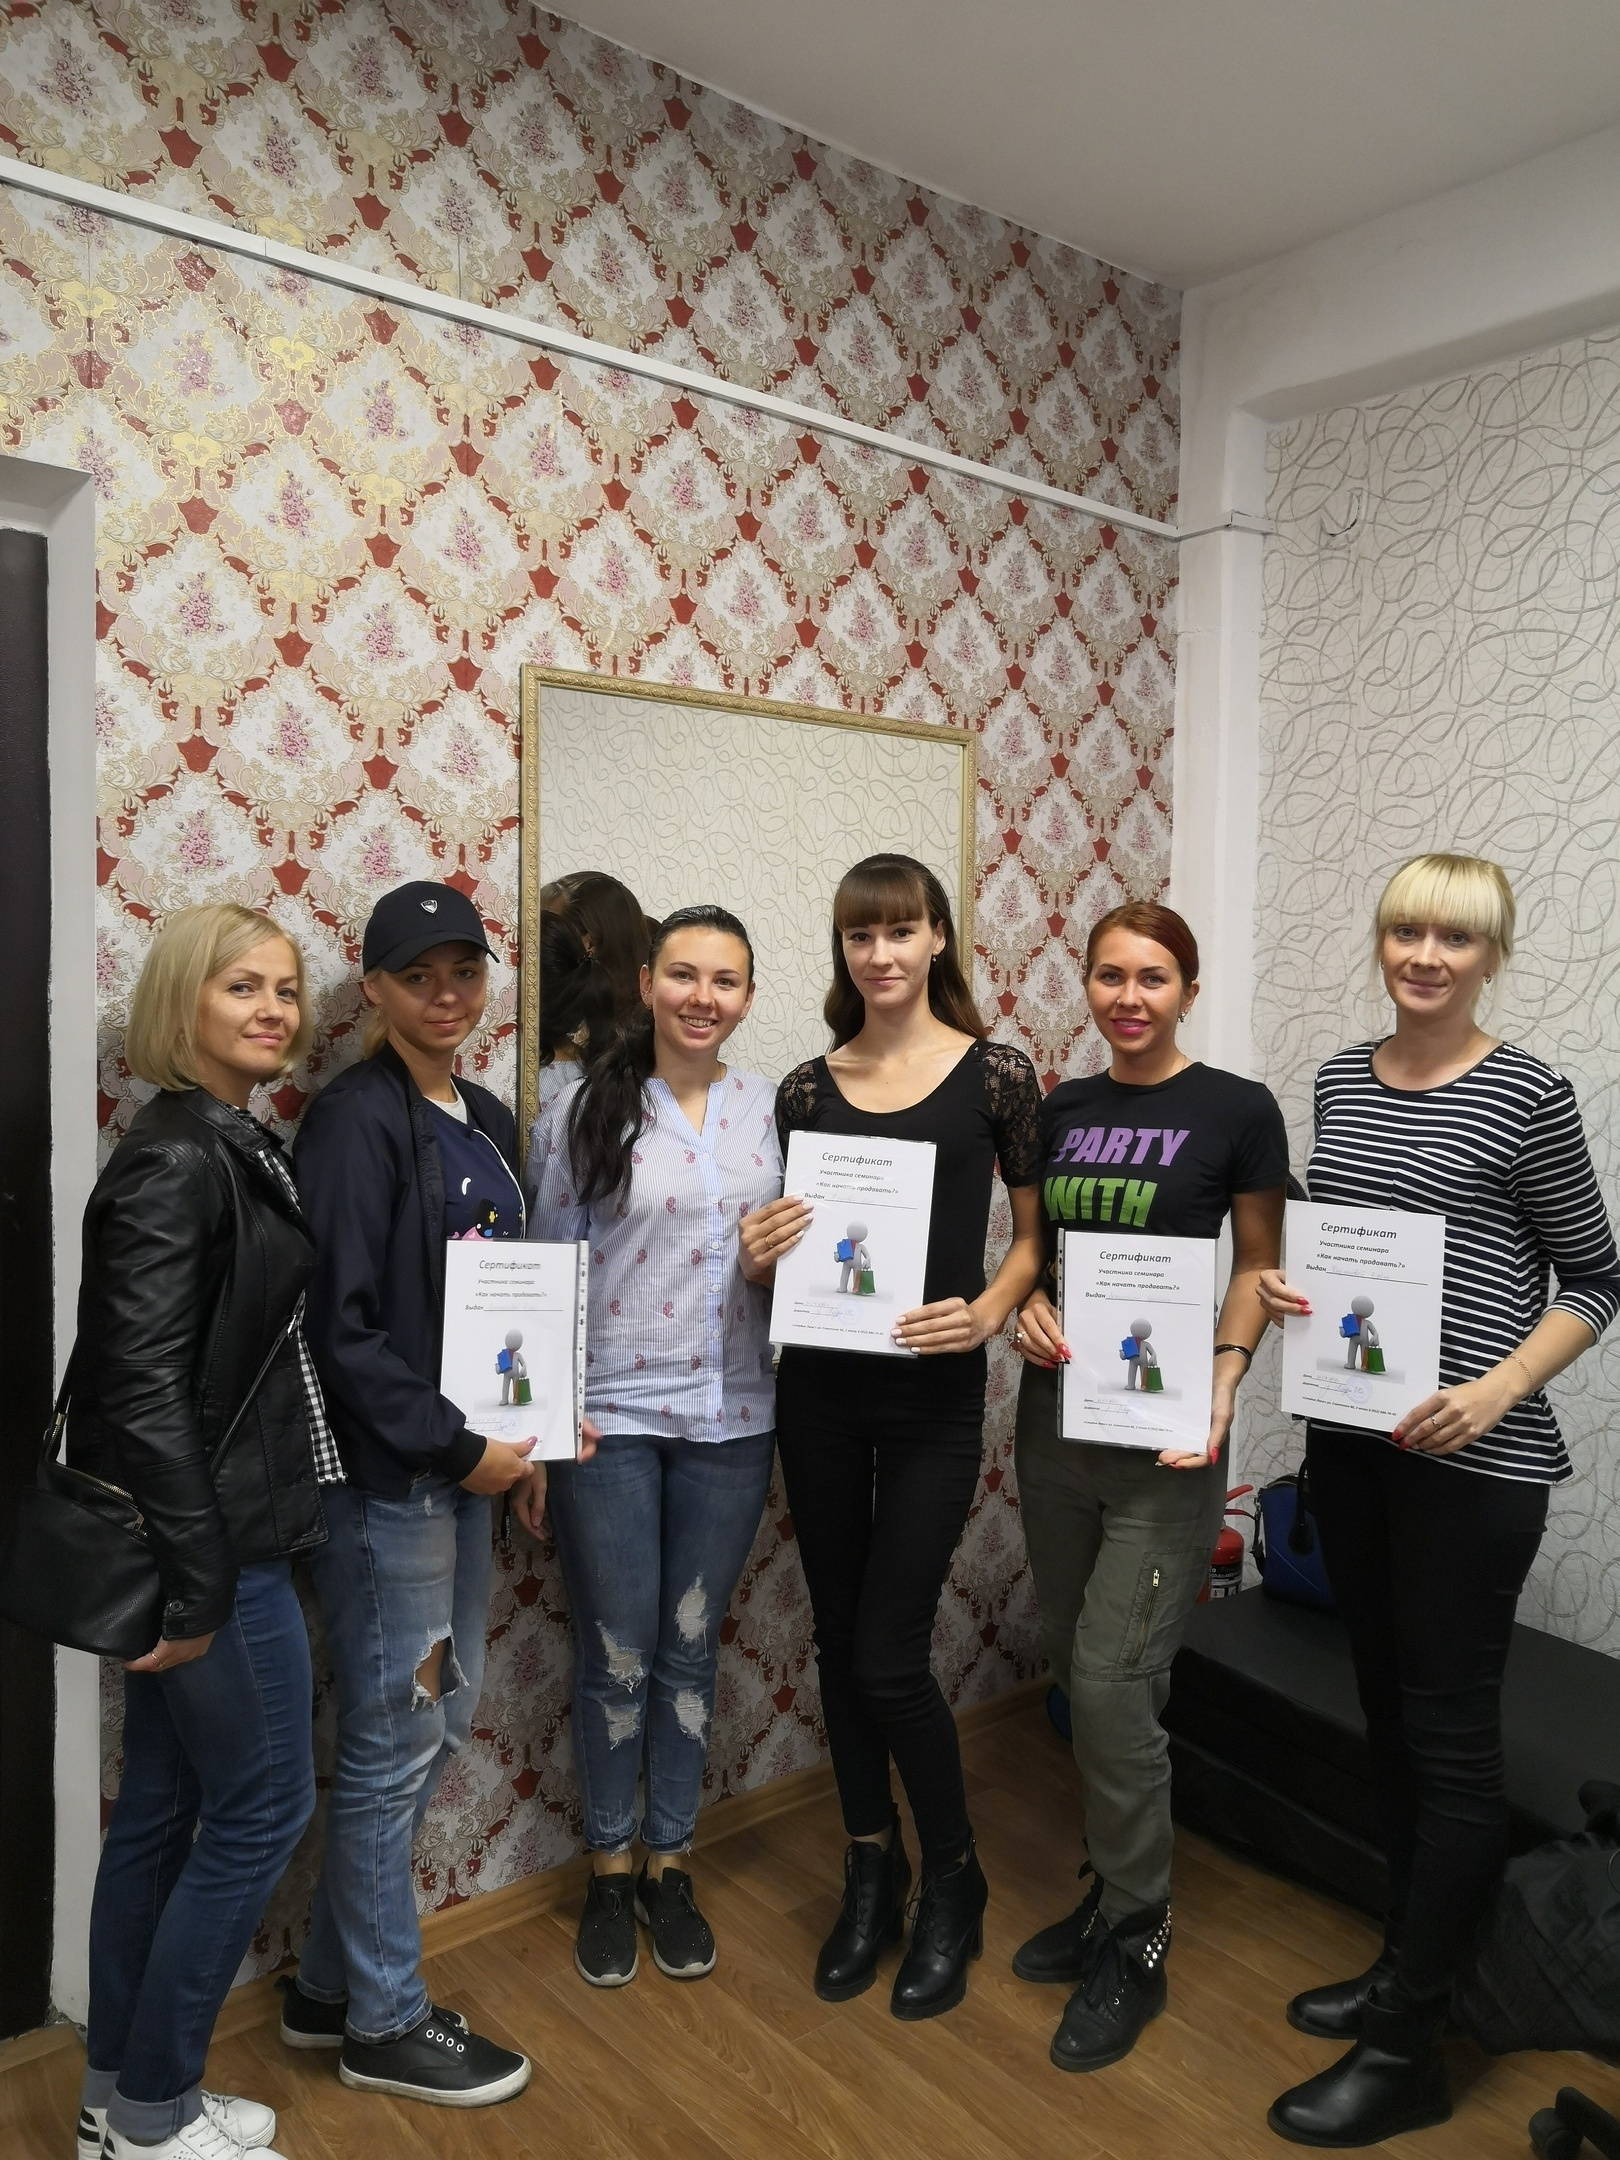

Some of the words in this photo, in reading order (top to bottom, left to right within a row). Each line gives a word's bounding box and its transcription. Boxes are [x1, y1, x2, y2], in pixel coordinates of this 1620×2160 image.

[1053, 1127, 1191, 1166] PARTY
[822, 1152, 893, 1167] Сертификат
[819, 1169, 853, 1178] Участника
[1044, 1176, 1158, 1227] WITH
[1321, 1222, 1397, 1239] Сертификат
[1319, 1240, 1355, 1250] Участника
[1356, 1245, 1389, 1254] семинара
[1099, 1250, 1171, 1264] Сертификат
[1333, 1254, 1358, 1263] начать
[479, 1260, 541, 1271] Сертификат
[1098, 1268, 1133, 1276] Участника
[1305, 1264, 1327, 1272] Выдан
